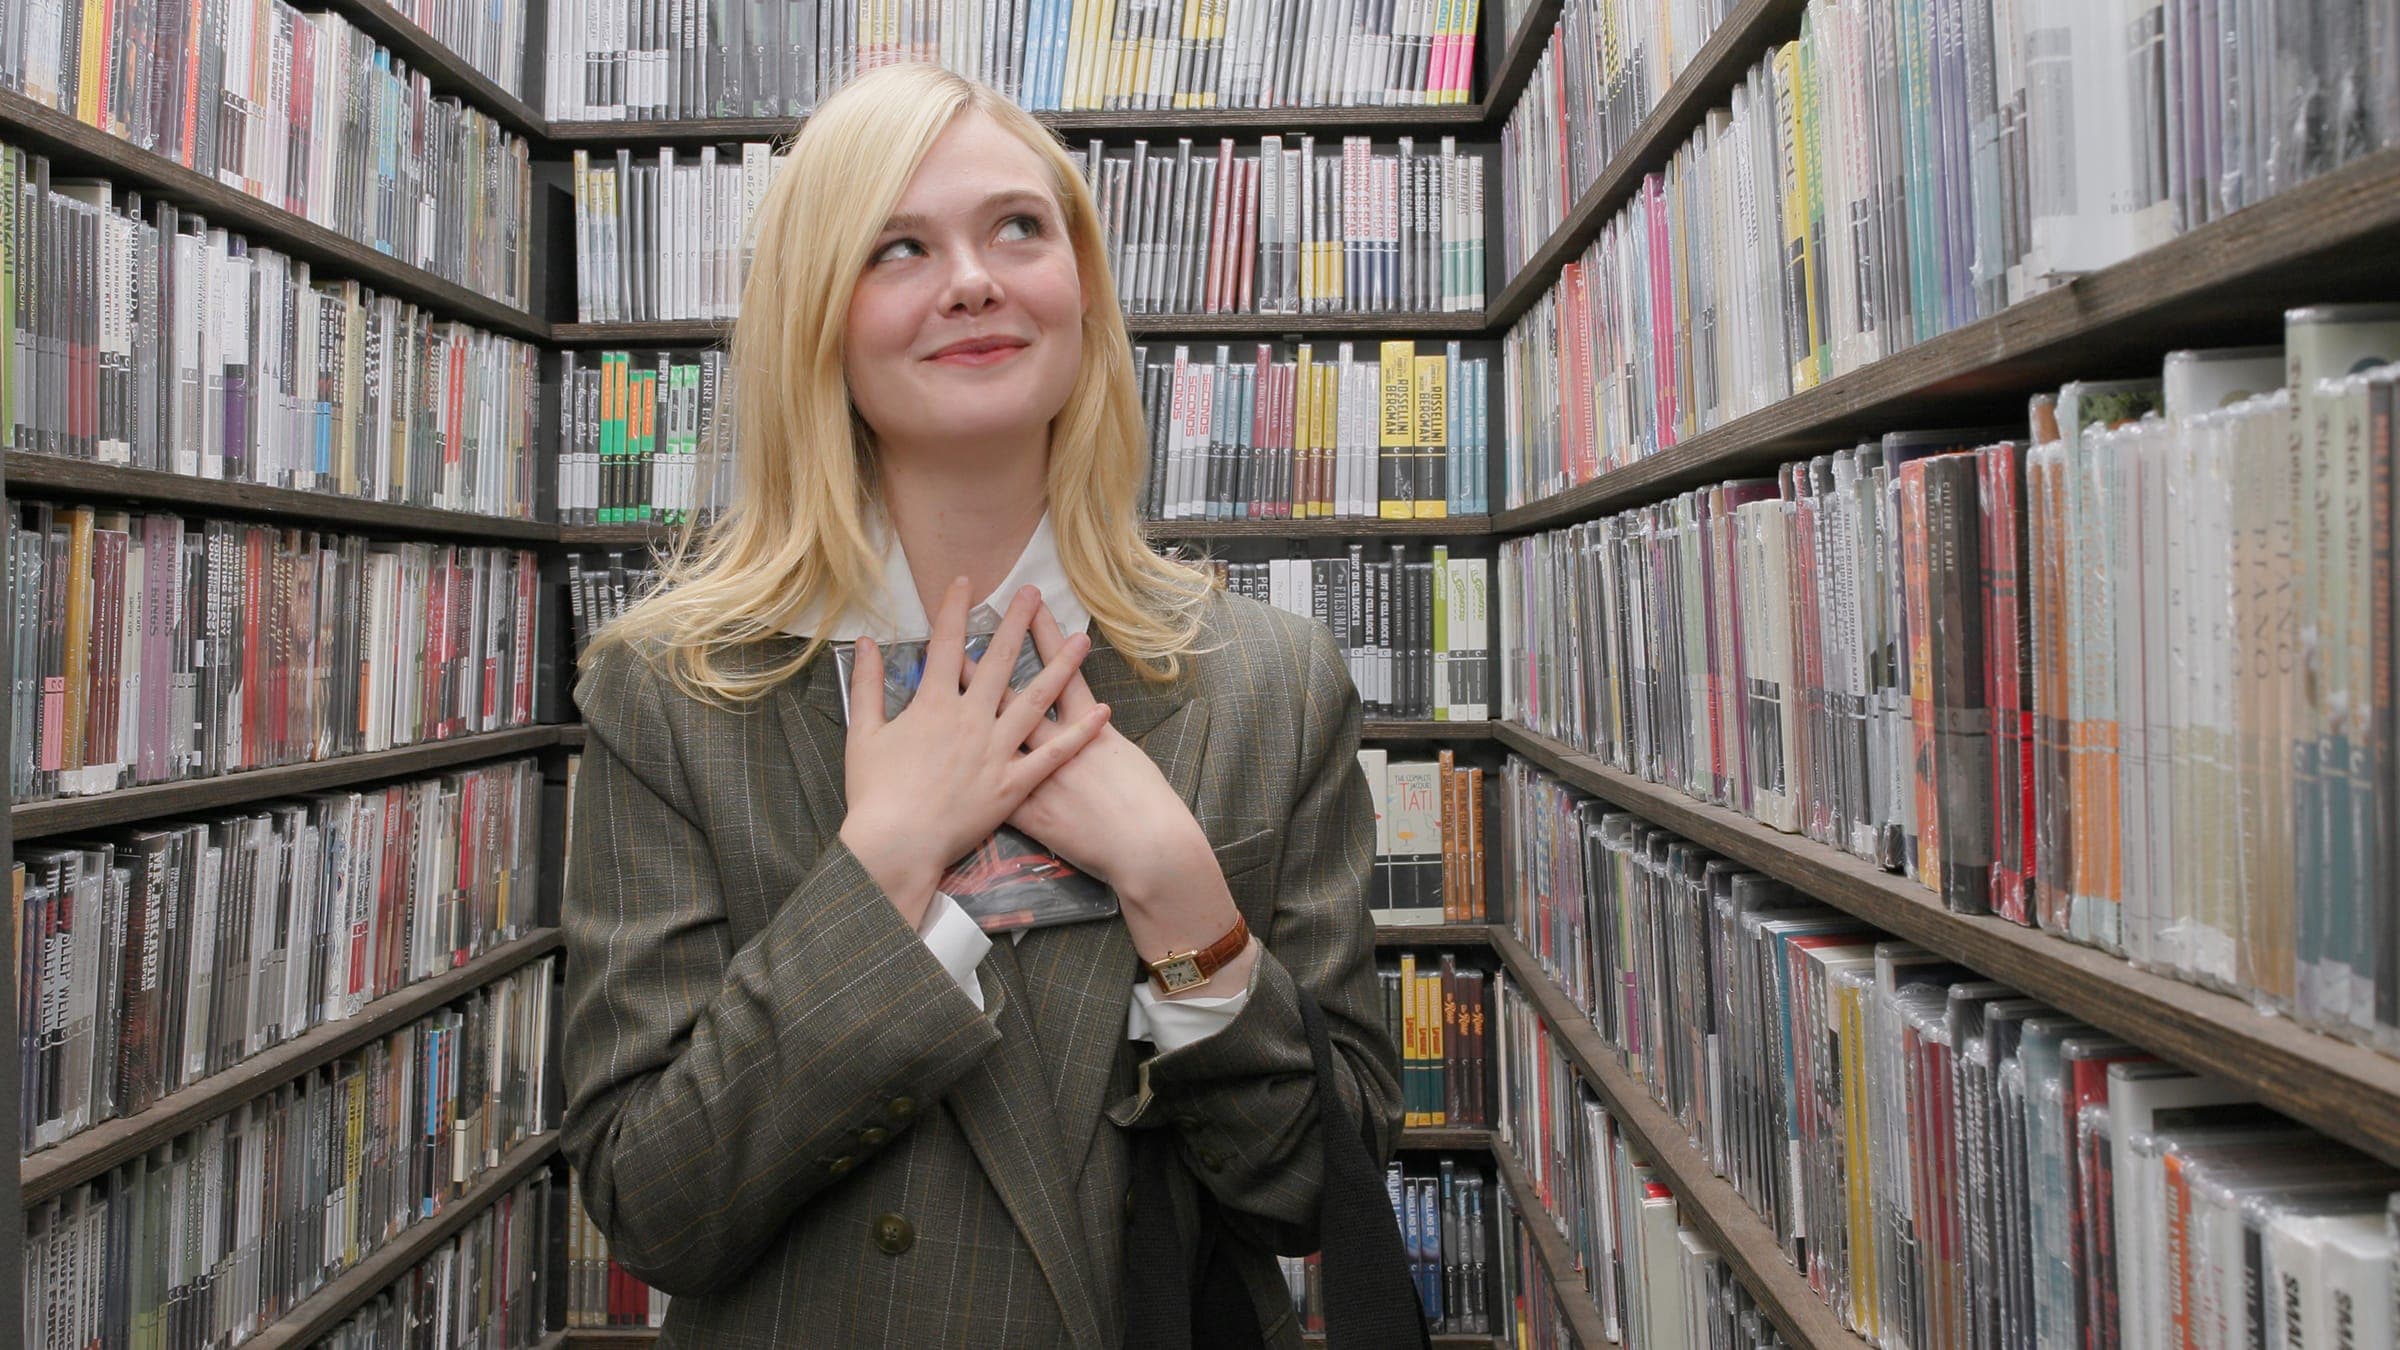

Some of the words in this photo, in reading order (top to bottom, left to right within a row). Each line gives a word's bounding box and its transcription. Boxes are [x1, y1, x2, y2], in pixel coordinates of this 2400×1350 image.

[671, 4, 680, 33] ROOM
[684, 20, 694, 49] ROOM
[1286, 172, 1299, 186] THE
[1402, 170, 1412, 186] MAN
[1415, 166, 1426, 176] A
[1415, 178, 1426, 193] MAN
[1429, 166, 1440, 176] A
[1429, 178, 1440, 193] MAN
[1266, 172, 1276, 218] WATERFRONT
[1286, 186, 1299, 234] WATERFRONT
[1402, 188, 1412, 227] ESCAPED
[4, 172, 14, 274] FIDANZATI
[1415, 196, 1426, 232] ESCAPED
[1429, 196, 1440, 232] ESCAPED
[130, 210, 138, 293] UMBERTO
[703, 362, 714, 404] PIERRE
[1173, 358, 1184, 420] SECONDS
[1186, 376, 1198, 438] SECONDS
[1200, 374, 1211, 436] SECONDS
[1386, 385, 1396, 435] BERGMAN
[1397, 378, 1408, 435] ROSSELLINI
[1419, 392, 1430, 442] BERGMAN
[1431, 386, 1442, 442] ROSSELLINI
[702, 408, 713, 443] ETAIX
[1943, 482, 1952, 530] CITIZEN
[569, 566, 578, 580] THE
[1352, 554, 1360, 570] RIOT
[1946, 542, 1954, 572] KANE
[615, 585, 624, 597] La
[1352, 572, 1360, 580] IN
[1352, 581, 1360, 597] CELL
[1366, 570, 1374, 586] RIOT
[1366, 588, 1374, 596] IN
[1380, 574, 1389, 590] RIOT
[1334, 586, 1346, 639] FRESHMAN
[1352, 598, 1360, 620] BLOCK
[1366, 598, 1374, 613] CELL
[1380, 592, 1389, 600] IN
[1380, 602, 1389, 616] CELL
[2254, 528, 2270, 680] PIANO
[2275, 519, 2290, 675] PIANO
[270, 607, 278, 640] CITY
[1366, 614, 1374, 636] BLOCK
[1380, 618, 1389, 639] BLOCK
[1399, 782, 1432, 812] TATI
[47, 868, 60, 896] THE
[64, 866, 76, 892] THE
[152, 851, 162, 892] MR.
[143, 884, 153, 954] CONFIDENTIAL
[60, 936, 72, 980] SLEEP
[147, 892, 160, 991] ARKADIN
[44, 938, 57, 985] SLEEP
[42, 990, 56, 1033] WELL
[57, 986, 71, 1028] WELL
[1444, 1002, 1456, 1025] Rose
[1458, 1013, 1470, 1036] Rose
[1472, 1013, 1484, 1036] Rose
[1408, 1185, 1416, 1225] MULHOLLAND
[1426, 1185, 1434, 1225] MULHOLLAND
